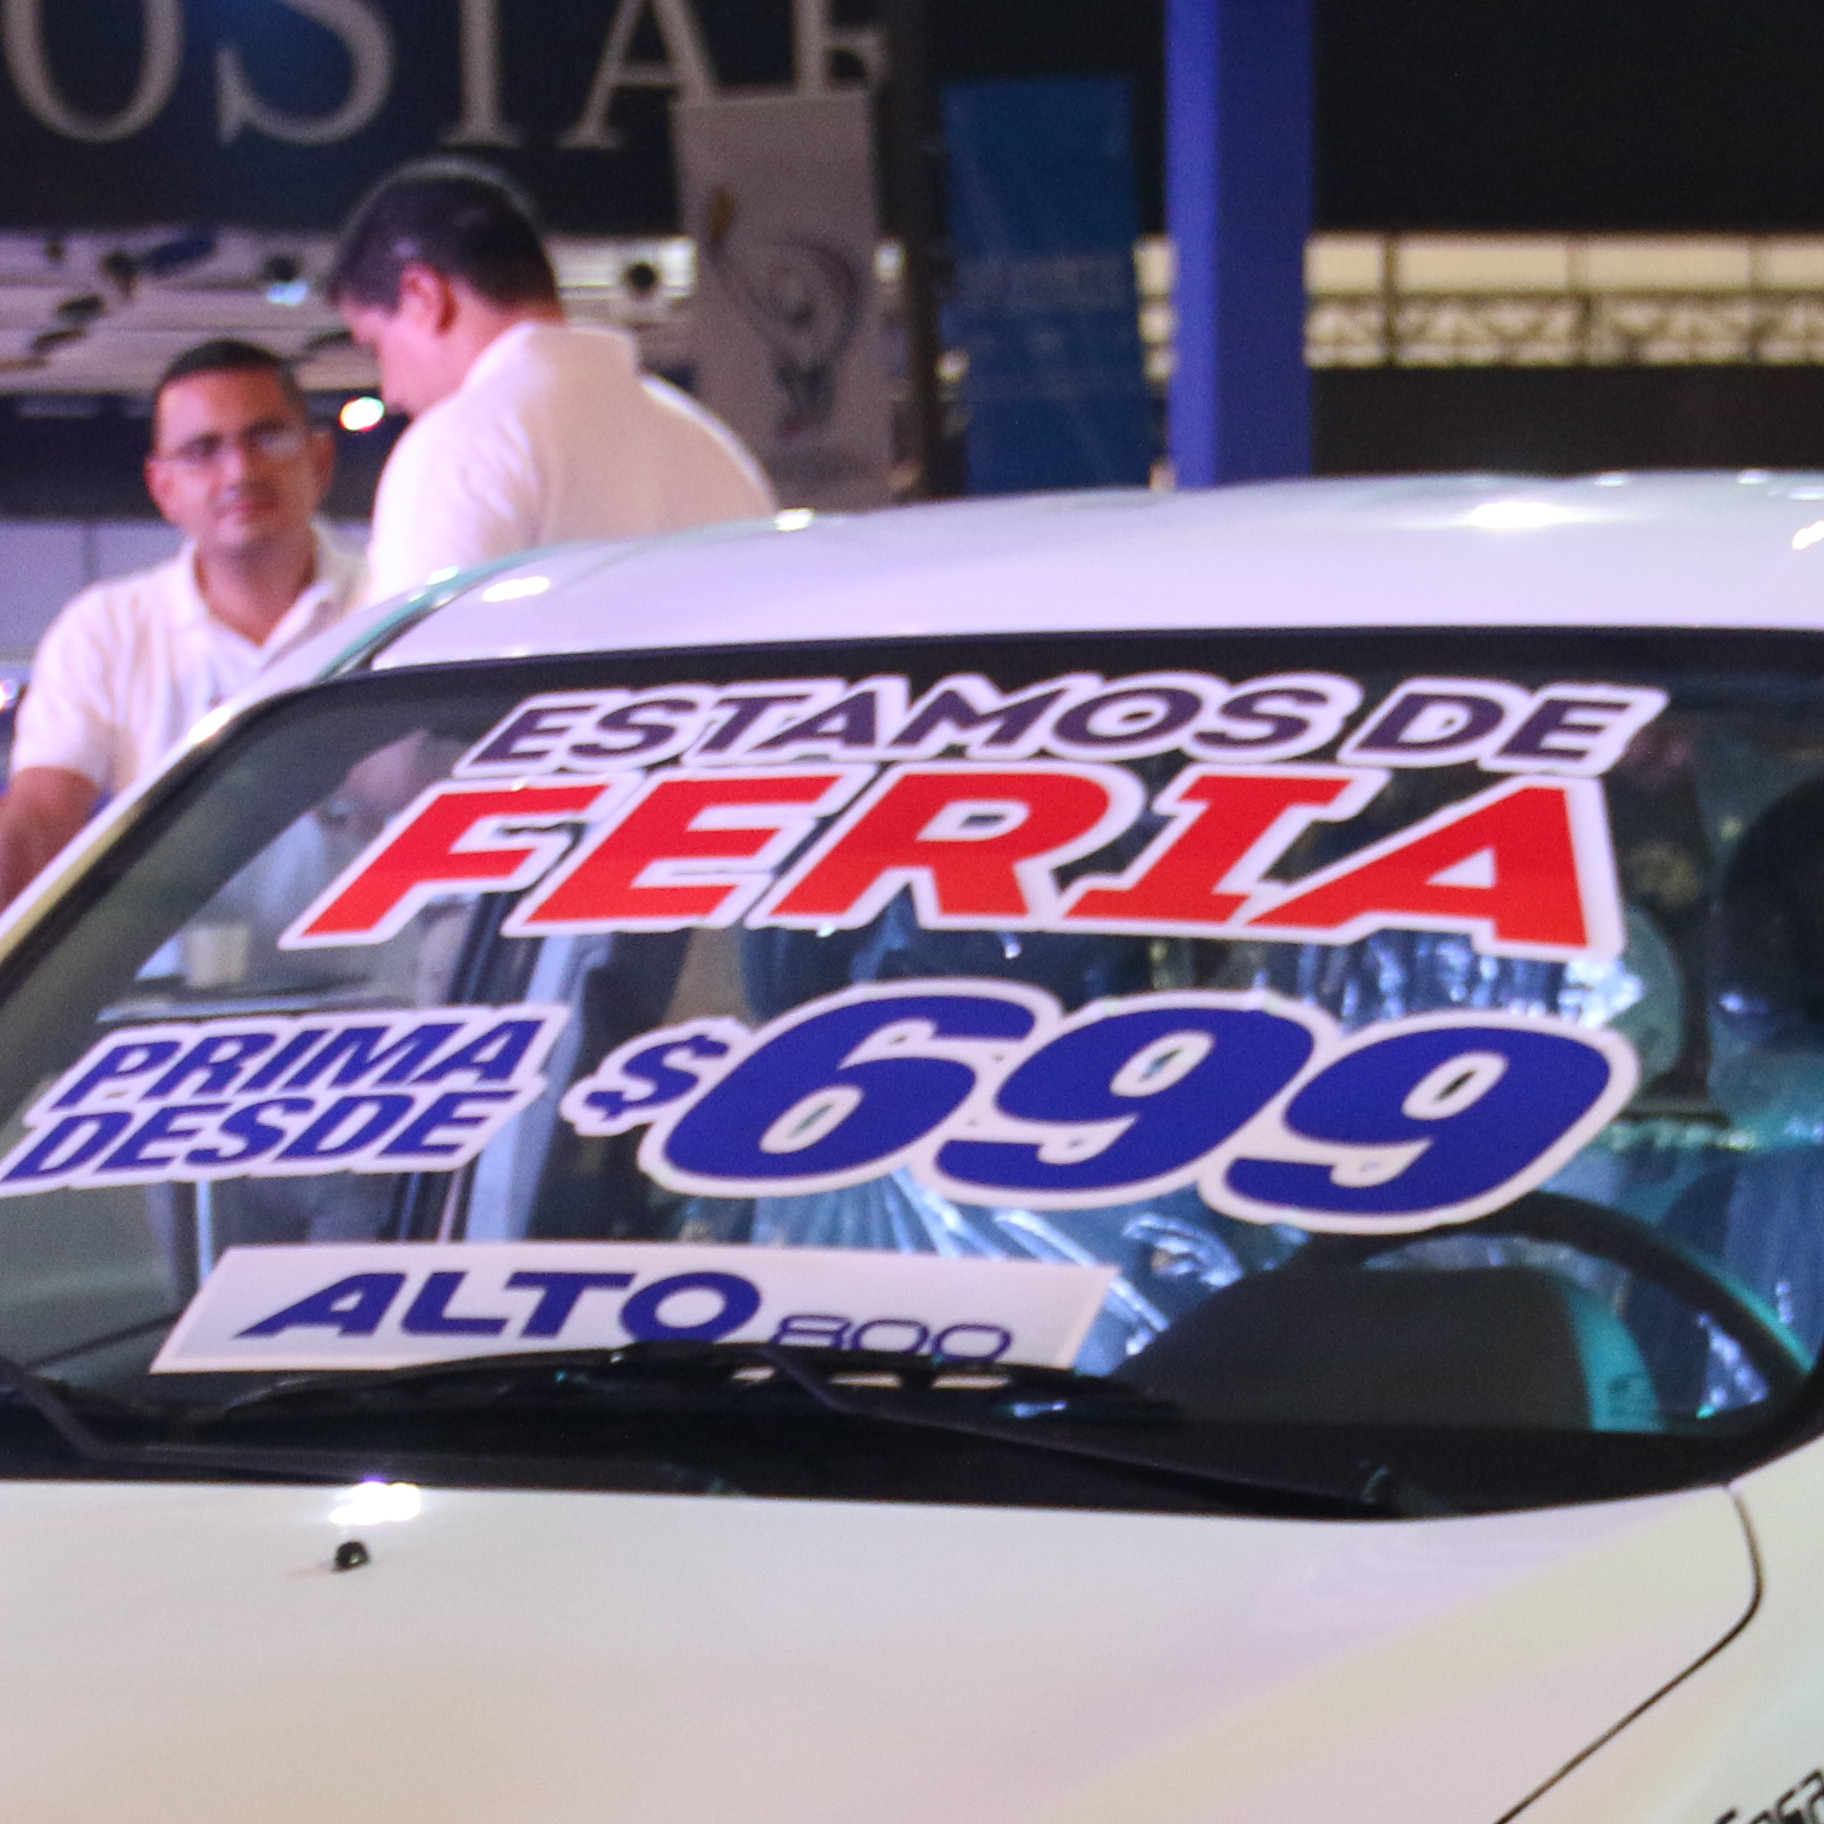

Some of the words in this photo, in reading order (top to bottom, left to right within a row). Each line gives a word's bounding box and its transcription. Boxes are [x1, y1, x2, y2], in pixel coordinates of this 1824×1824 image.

[462, 682, 1334, 769] ESTAMOS
[1350, 687, 1638, 764] DE
[293, 766, 1595, 952] FERIA
[42, 1014, 552, 1114] PRIMA
[576, 988, 1618, 1221] $699
[232, 1270, 762, 1345] ALTO
[773, 1313, 1014, 1366] 800
